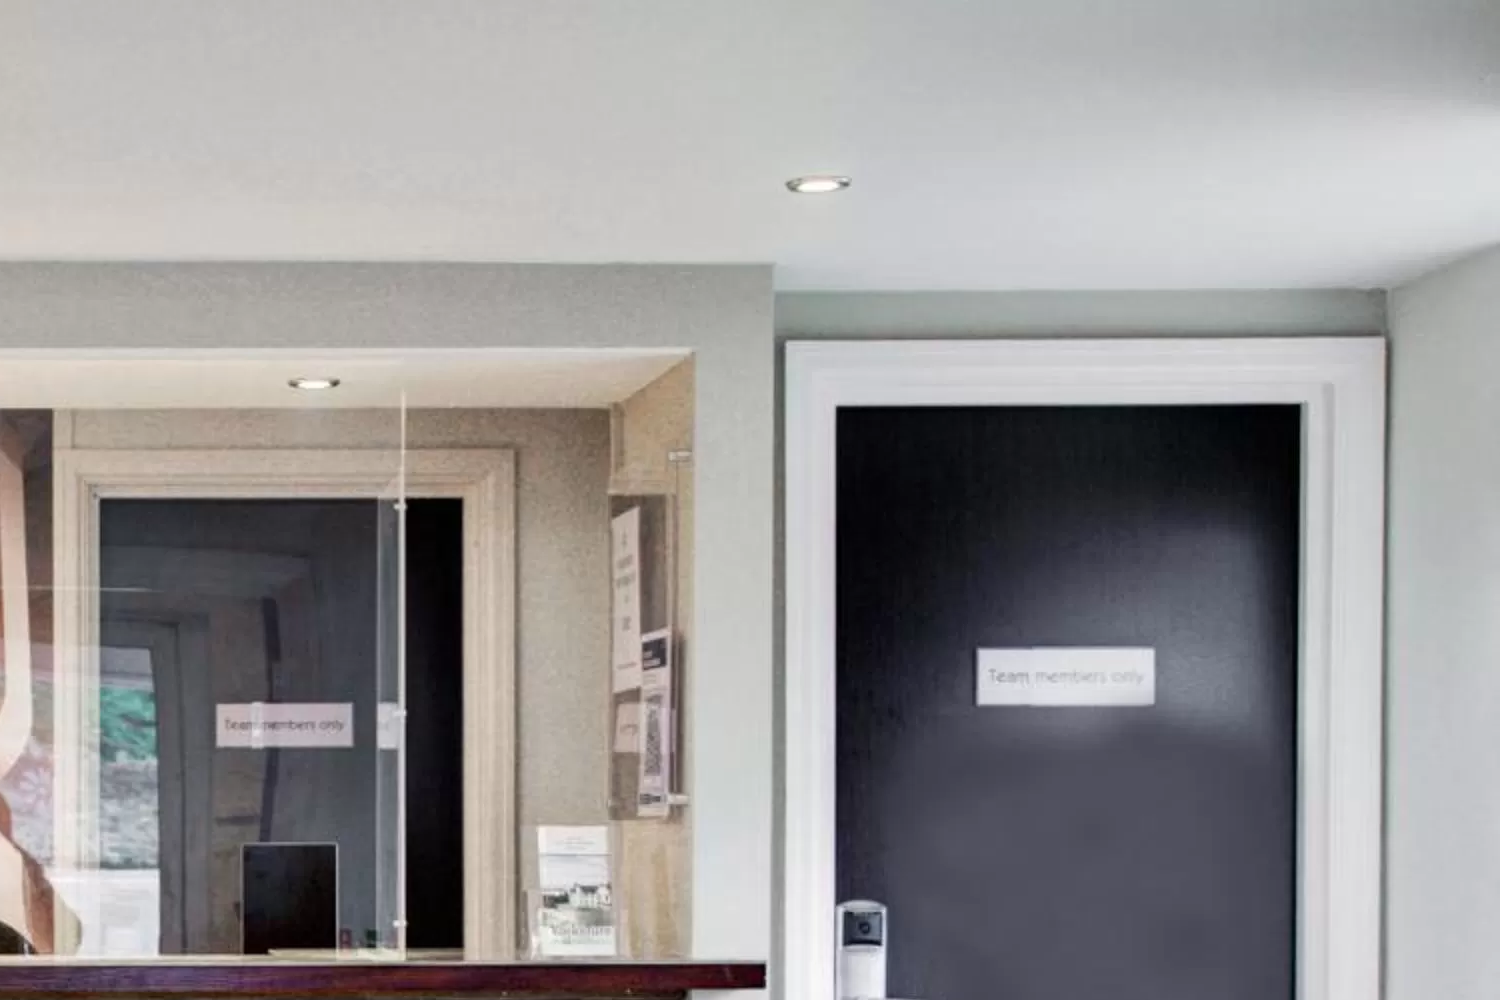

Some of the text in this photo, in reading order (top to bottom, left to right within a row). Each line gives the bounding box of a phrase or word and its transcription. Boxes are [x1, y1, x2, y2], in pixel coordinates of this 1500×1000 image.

[988, 668, 1144, 685] Team members only
[318, 719, 344, 734] only
